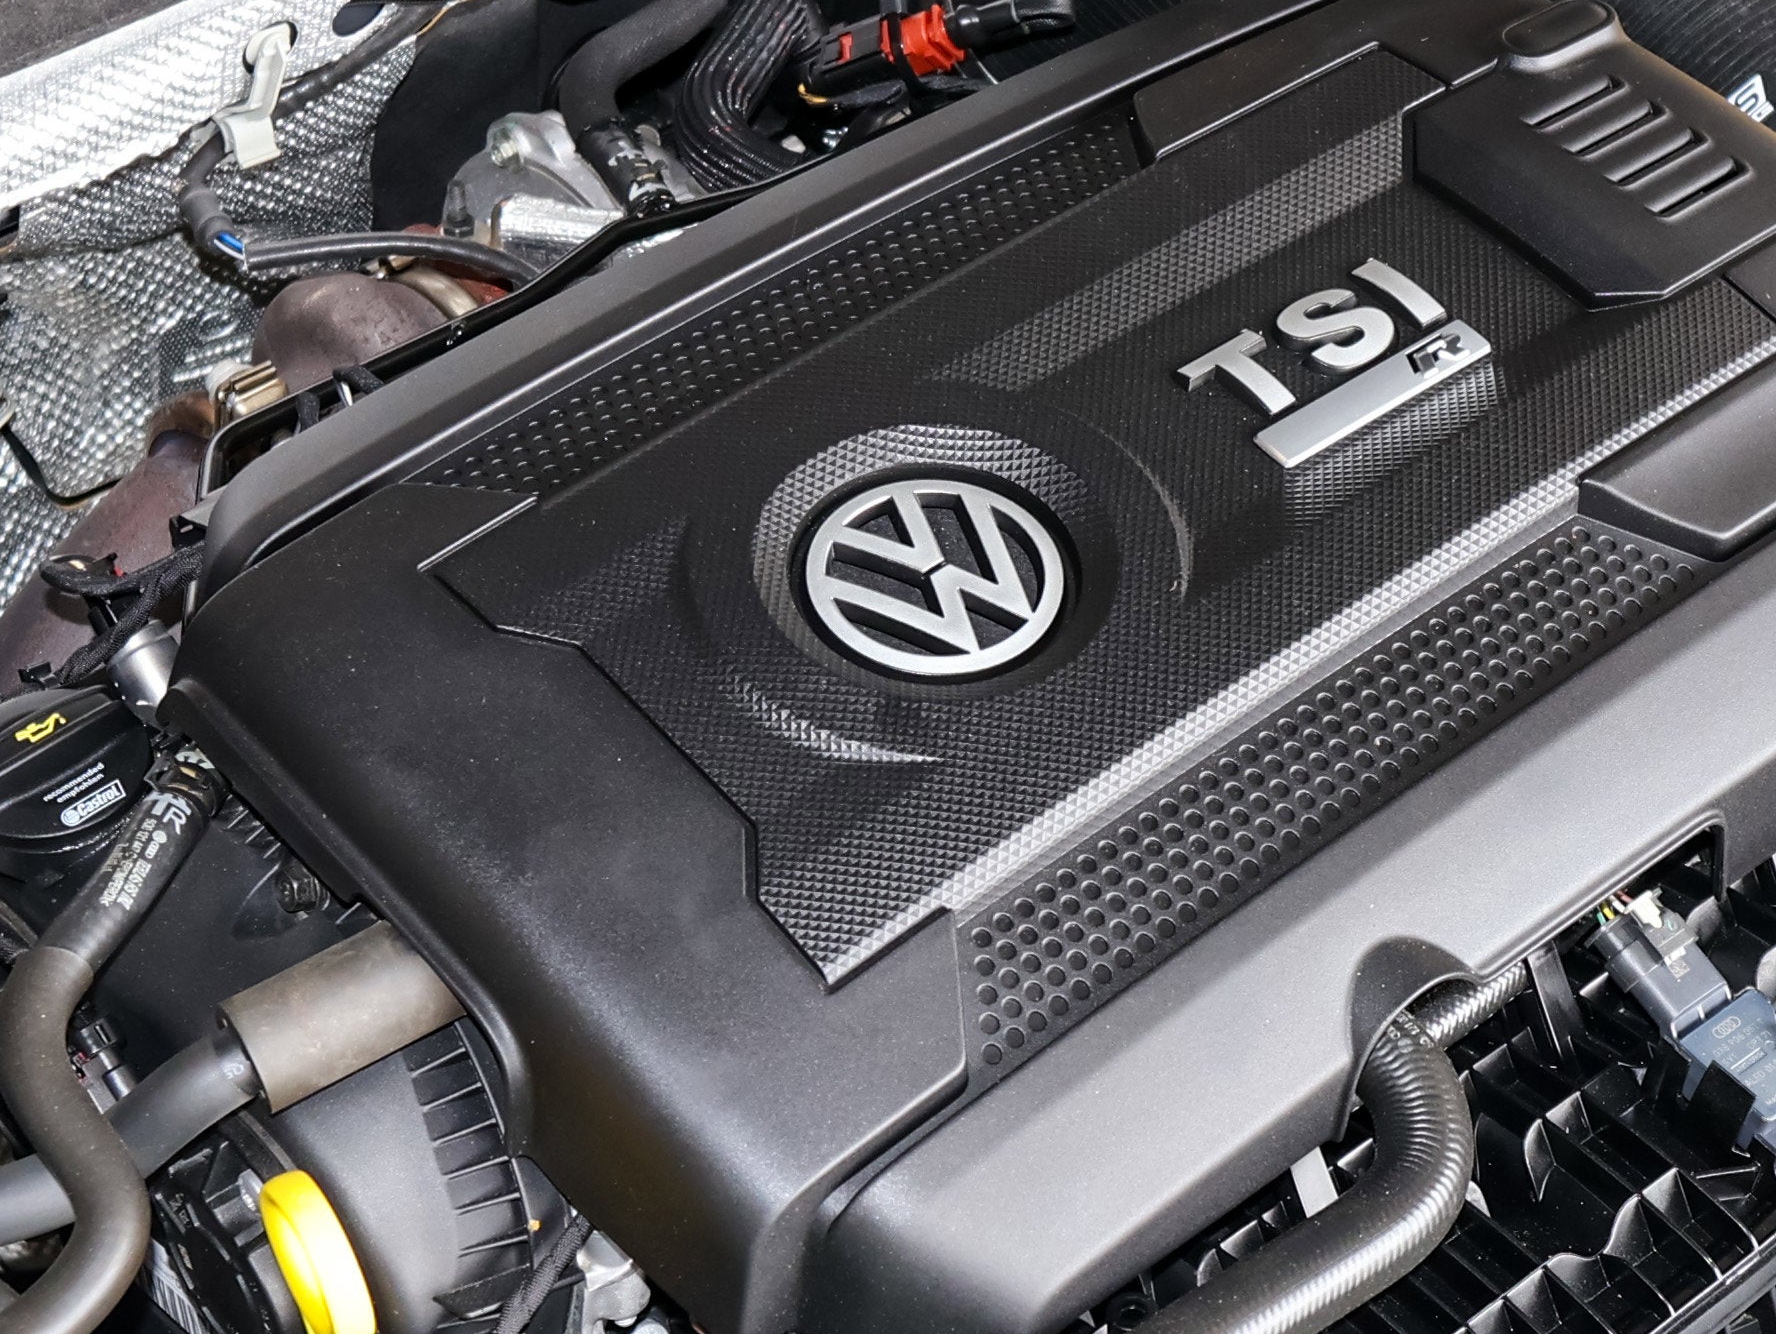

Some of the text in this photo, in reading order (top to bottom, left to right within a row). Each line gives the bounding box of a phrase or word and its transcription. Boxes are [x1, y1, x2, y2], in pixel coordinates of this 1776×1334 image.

[1175, 258, 1449, 417] TSI
[42, 761, 104, 802] recommended
[56, 772, 104, 803] empfohlen
[75, 784, 121, 817] Castrol
